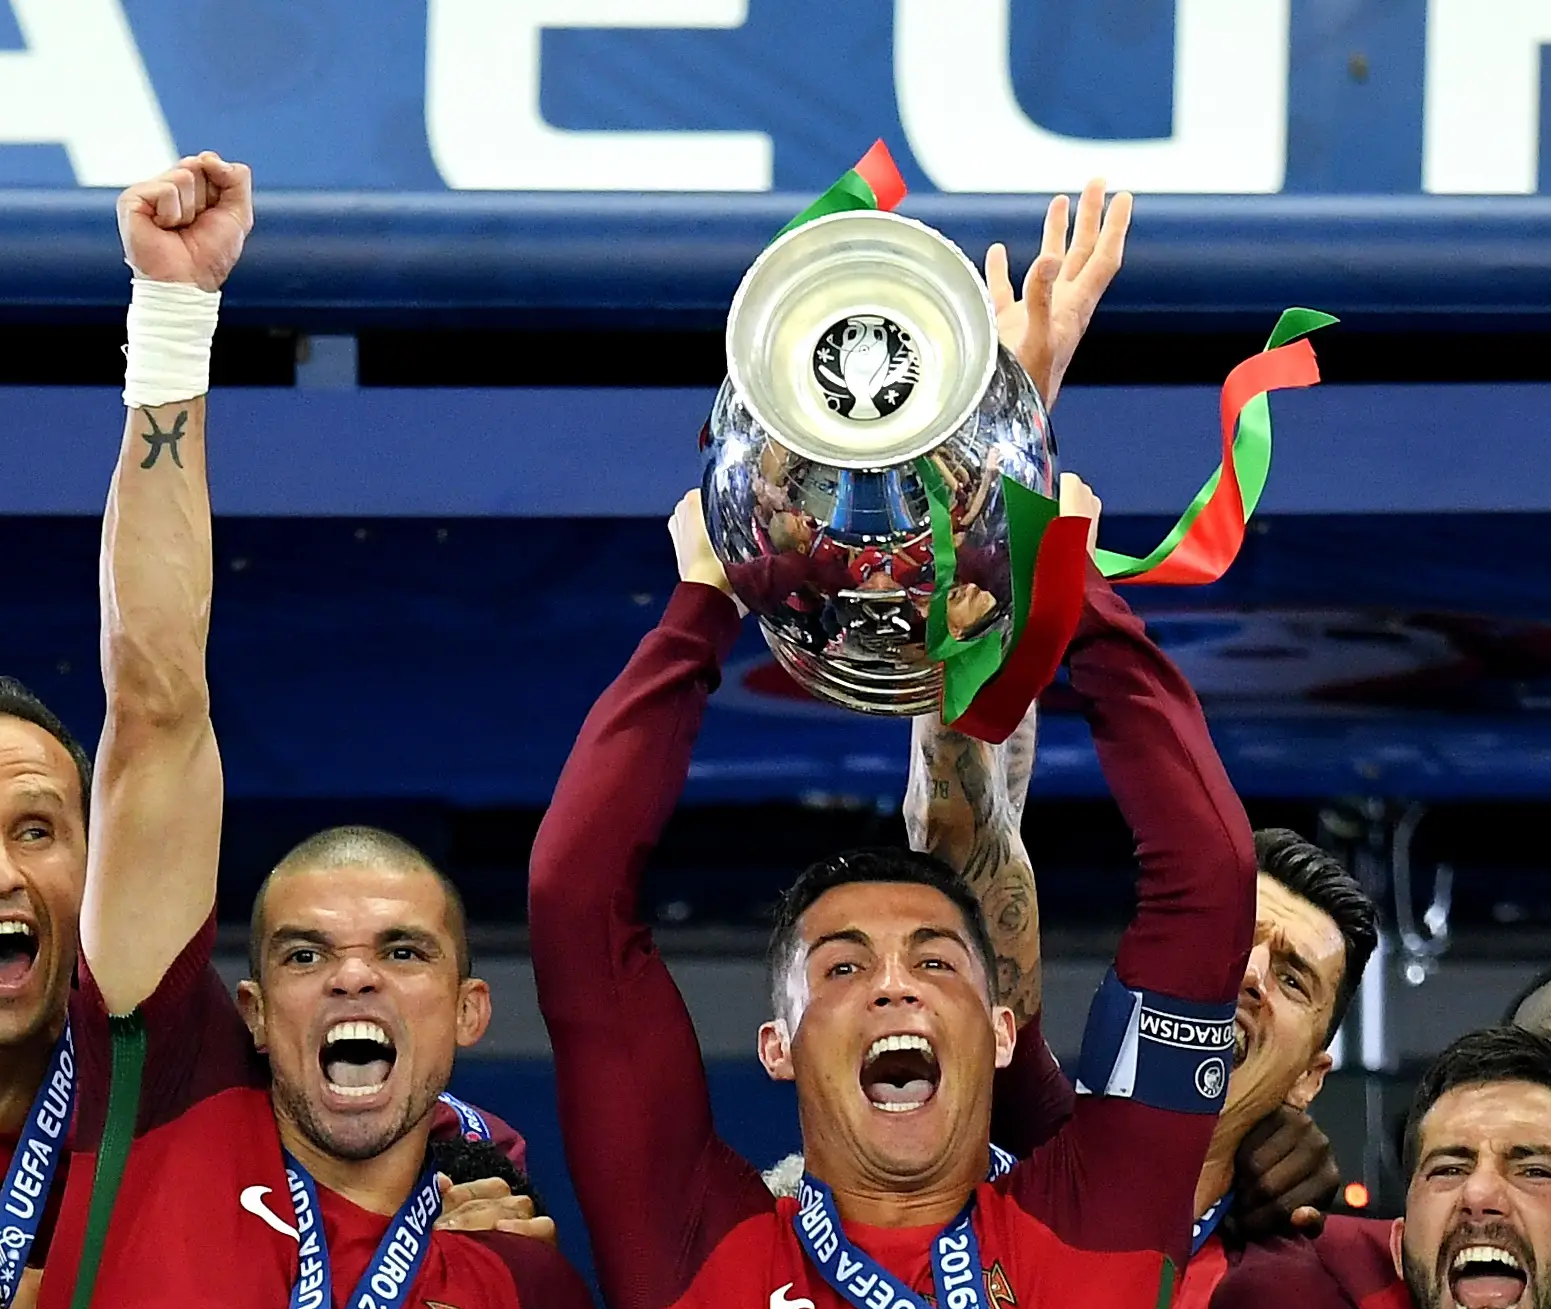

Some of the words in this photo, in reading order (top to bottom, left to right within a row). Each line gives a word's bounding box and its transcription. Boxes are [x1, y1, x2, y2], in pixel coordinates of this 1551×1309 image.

[5, 1138, 53, 1220] UEFA
[36, 1053, 75, 1140] EURO
[286, 1168, 316, 1235] EUR
[370, 1226, 420, 1301] EURO
